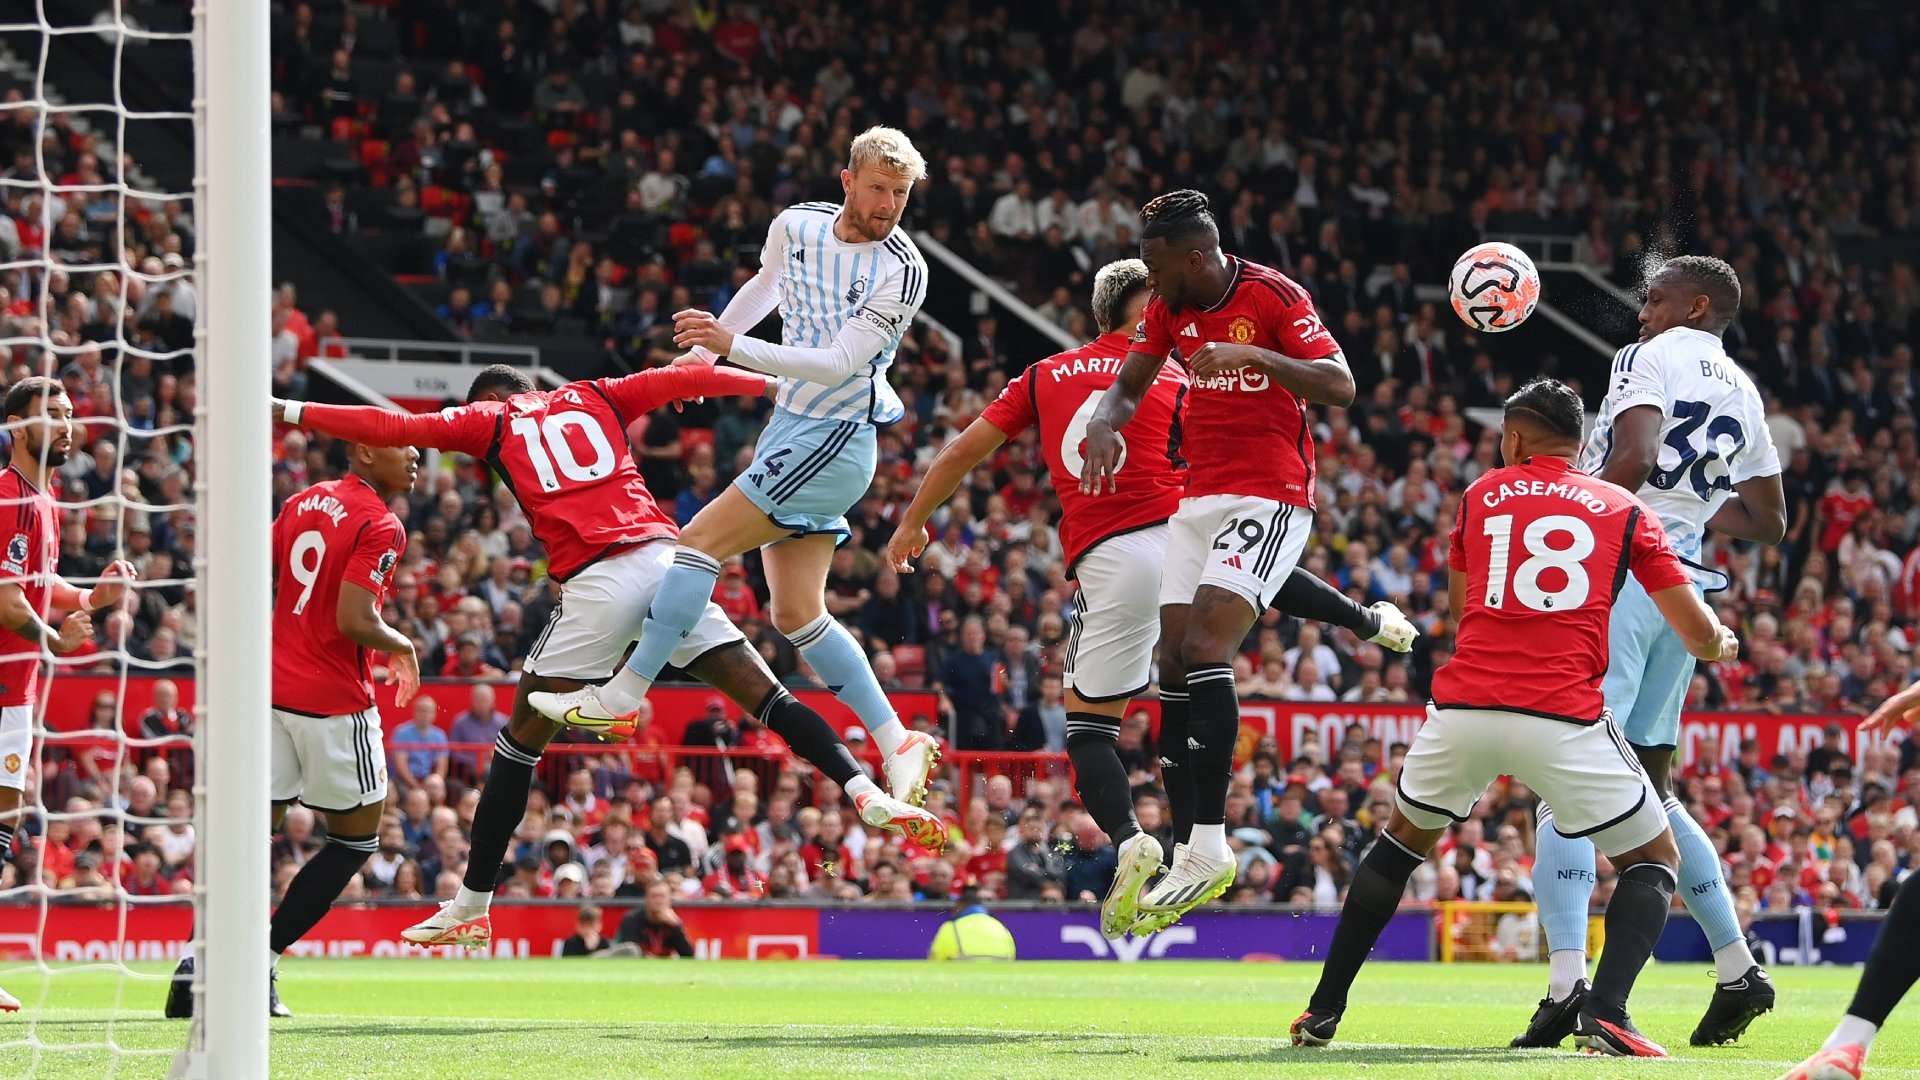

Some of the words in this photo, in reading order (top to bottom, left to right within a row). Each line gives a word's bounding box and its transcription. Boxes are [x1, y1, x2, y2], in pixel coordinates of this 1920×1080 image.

[510, 410, 616, 493] 10
[763, 447, 793, 478] 4
[1060, 389, 1127, 480] 6
[1482, 479, 1607, 514] CASEMIRO
[1212, 517, 1265, 554] 29
[1483, 514, 1596, 613] 18
[289, 529, 327, 616] 9
[1557, 868, 1595, 884] NFFC
